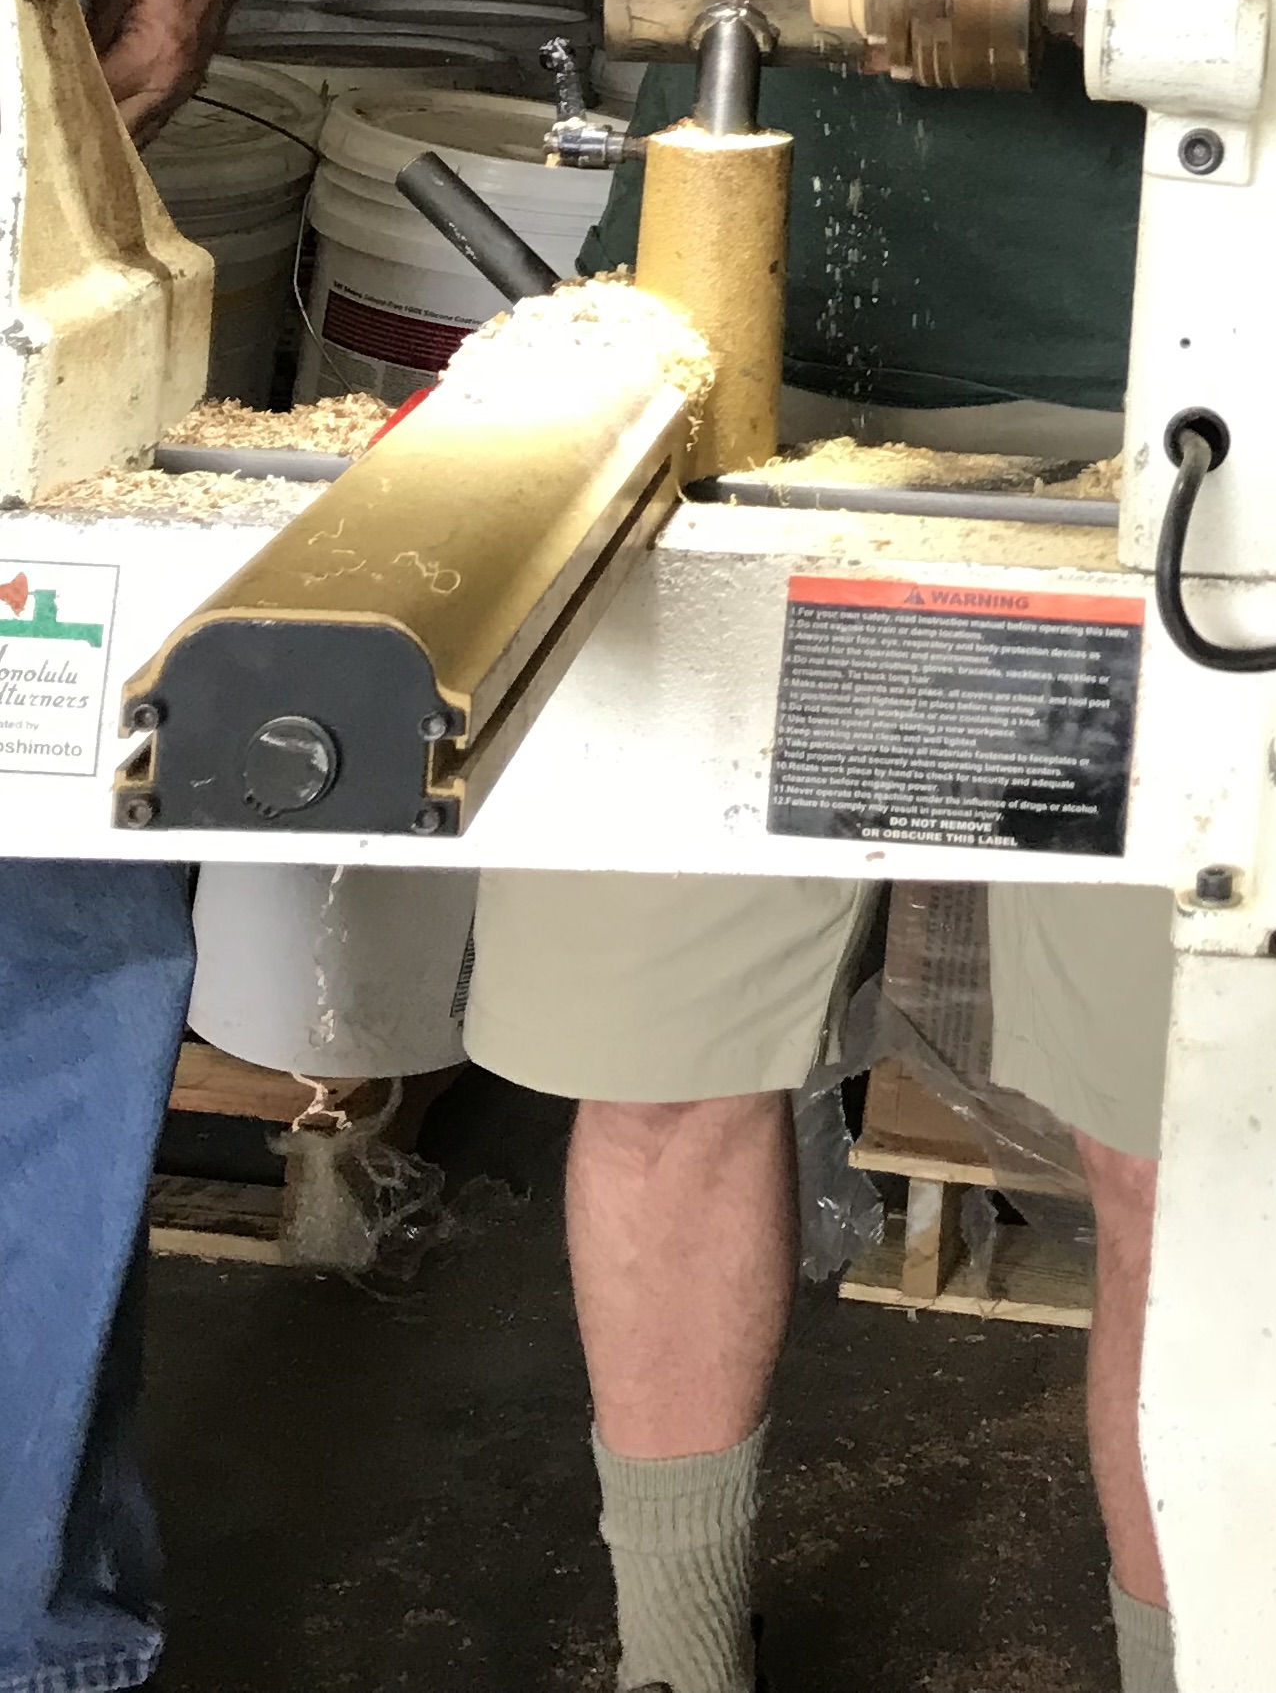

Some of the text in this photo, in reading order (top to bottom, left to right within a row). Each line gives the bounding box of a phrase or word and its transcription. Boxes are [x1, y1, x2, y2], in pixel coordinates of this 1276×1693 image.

[930, 590, 1029, 610] WARNING
[917, 615, 969, 626] instruction
[1006, 620, 1037, 631] before
[1038, 622, 1084, 636] operating
[1084, 625, 1103, 635] this
[26, 720, 40, 731] by
[873, 767, 886, 779] by
[819, 799, 830, 808] to
[831, 800, 867, 812] comply
[930, 806, 973, 819] personal
[945, 795, 960, 805] the
[962, 796, 1006, 807] influence
[1007, 799, 1019, 808] of
[1019, 800, 1048, 812] drugs
[1048, 803, 1060, 811] or
[888, 816, 993, 832] DO NOT REMOVE
[860, 826, 1019, 846] OR OBSCURE THIS LABEL
